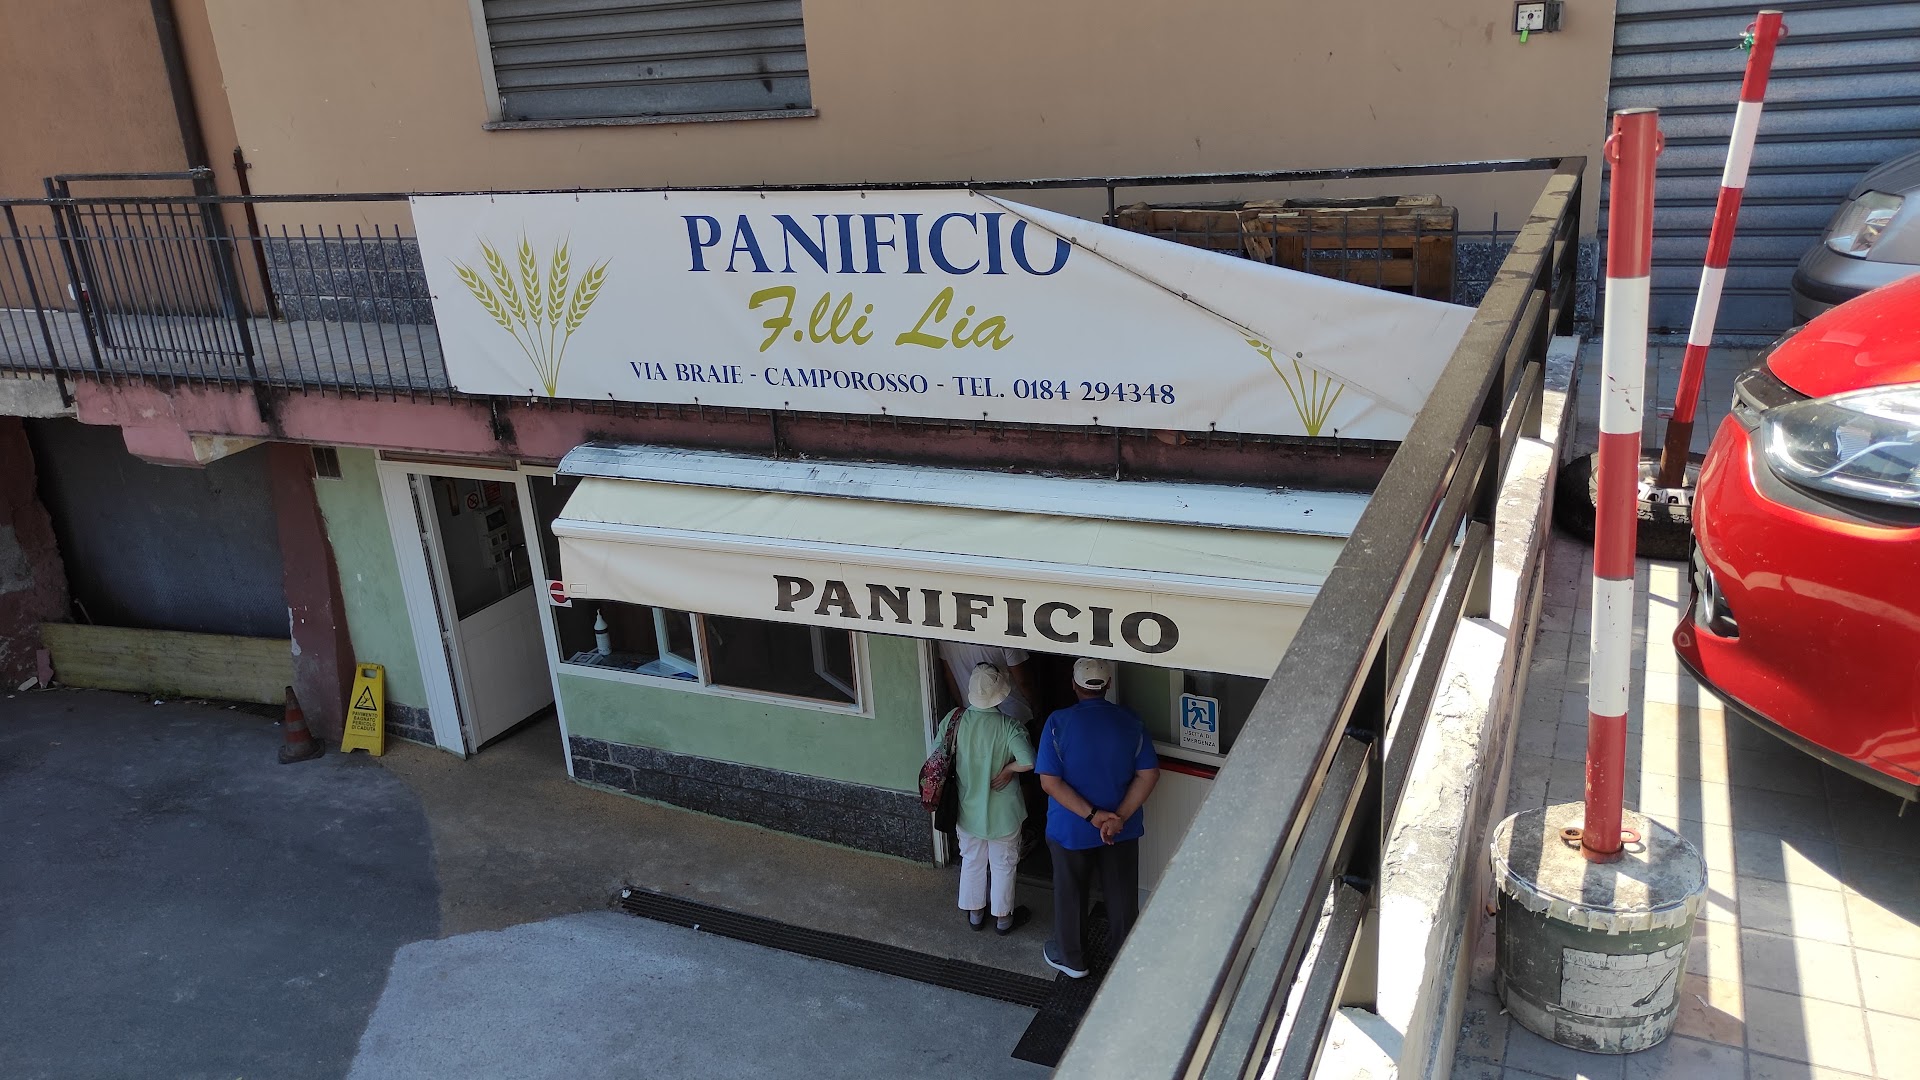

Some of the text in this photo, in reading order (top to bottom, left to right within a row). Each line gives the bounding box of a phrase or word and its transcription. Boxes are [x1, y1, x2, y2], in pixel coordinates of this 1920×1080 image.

[680, 212, 1072, 276] PANIFICIO
[748, 285, 1014, 352] F.lli Lia
[630, 361, 668, 381] VIA
[674, 363, 744, 384] BRAIE
[764, 367, 929, 394] CAMPOROSSO
[952, 376, 1005, 398] TEL.
[1013, 378, 1071, 400] 0184
[1079, 381, 1176, 405] 294348
[772, 574, 1180, 654] PANIFICIO
[1183, 737, 1216, 747] EMERGENZA
